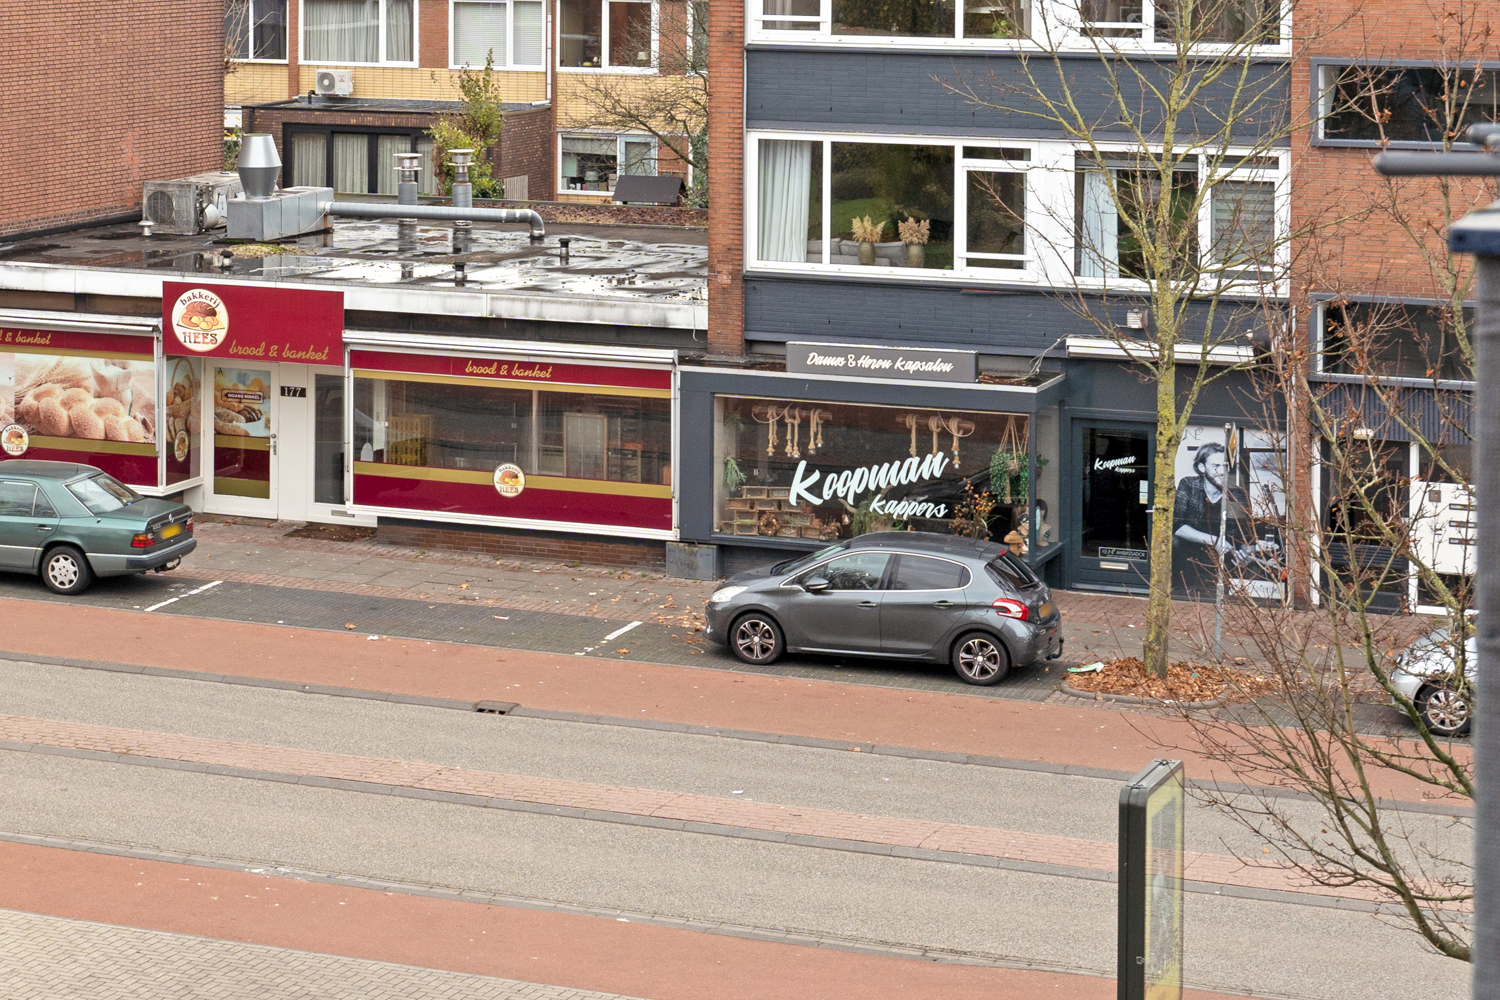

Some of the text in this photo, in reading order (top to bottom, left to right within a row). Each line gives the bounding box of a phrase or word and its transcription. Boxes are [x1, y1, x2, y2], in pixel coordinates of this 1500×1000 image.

[179, 291, 222, 309] bakkerij
[5, 332, 13, 342] &
[15, 331, 52, 345] banket
[182, 331, 218, 345] HEES
[229, 339, 329, 361] brood & banket
[847, 354, 857, 368] &
[465, 360, 553, 379] brood & banket
[284, 386, 301, 397] 177
[1093, 455, 1136, 470] Koopman
[788, 451, 949, 506] Koopman
